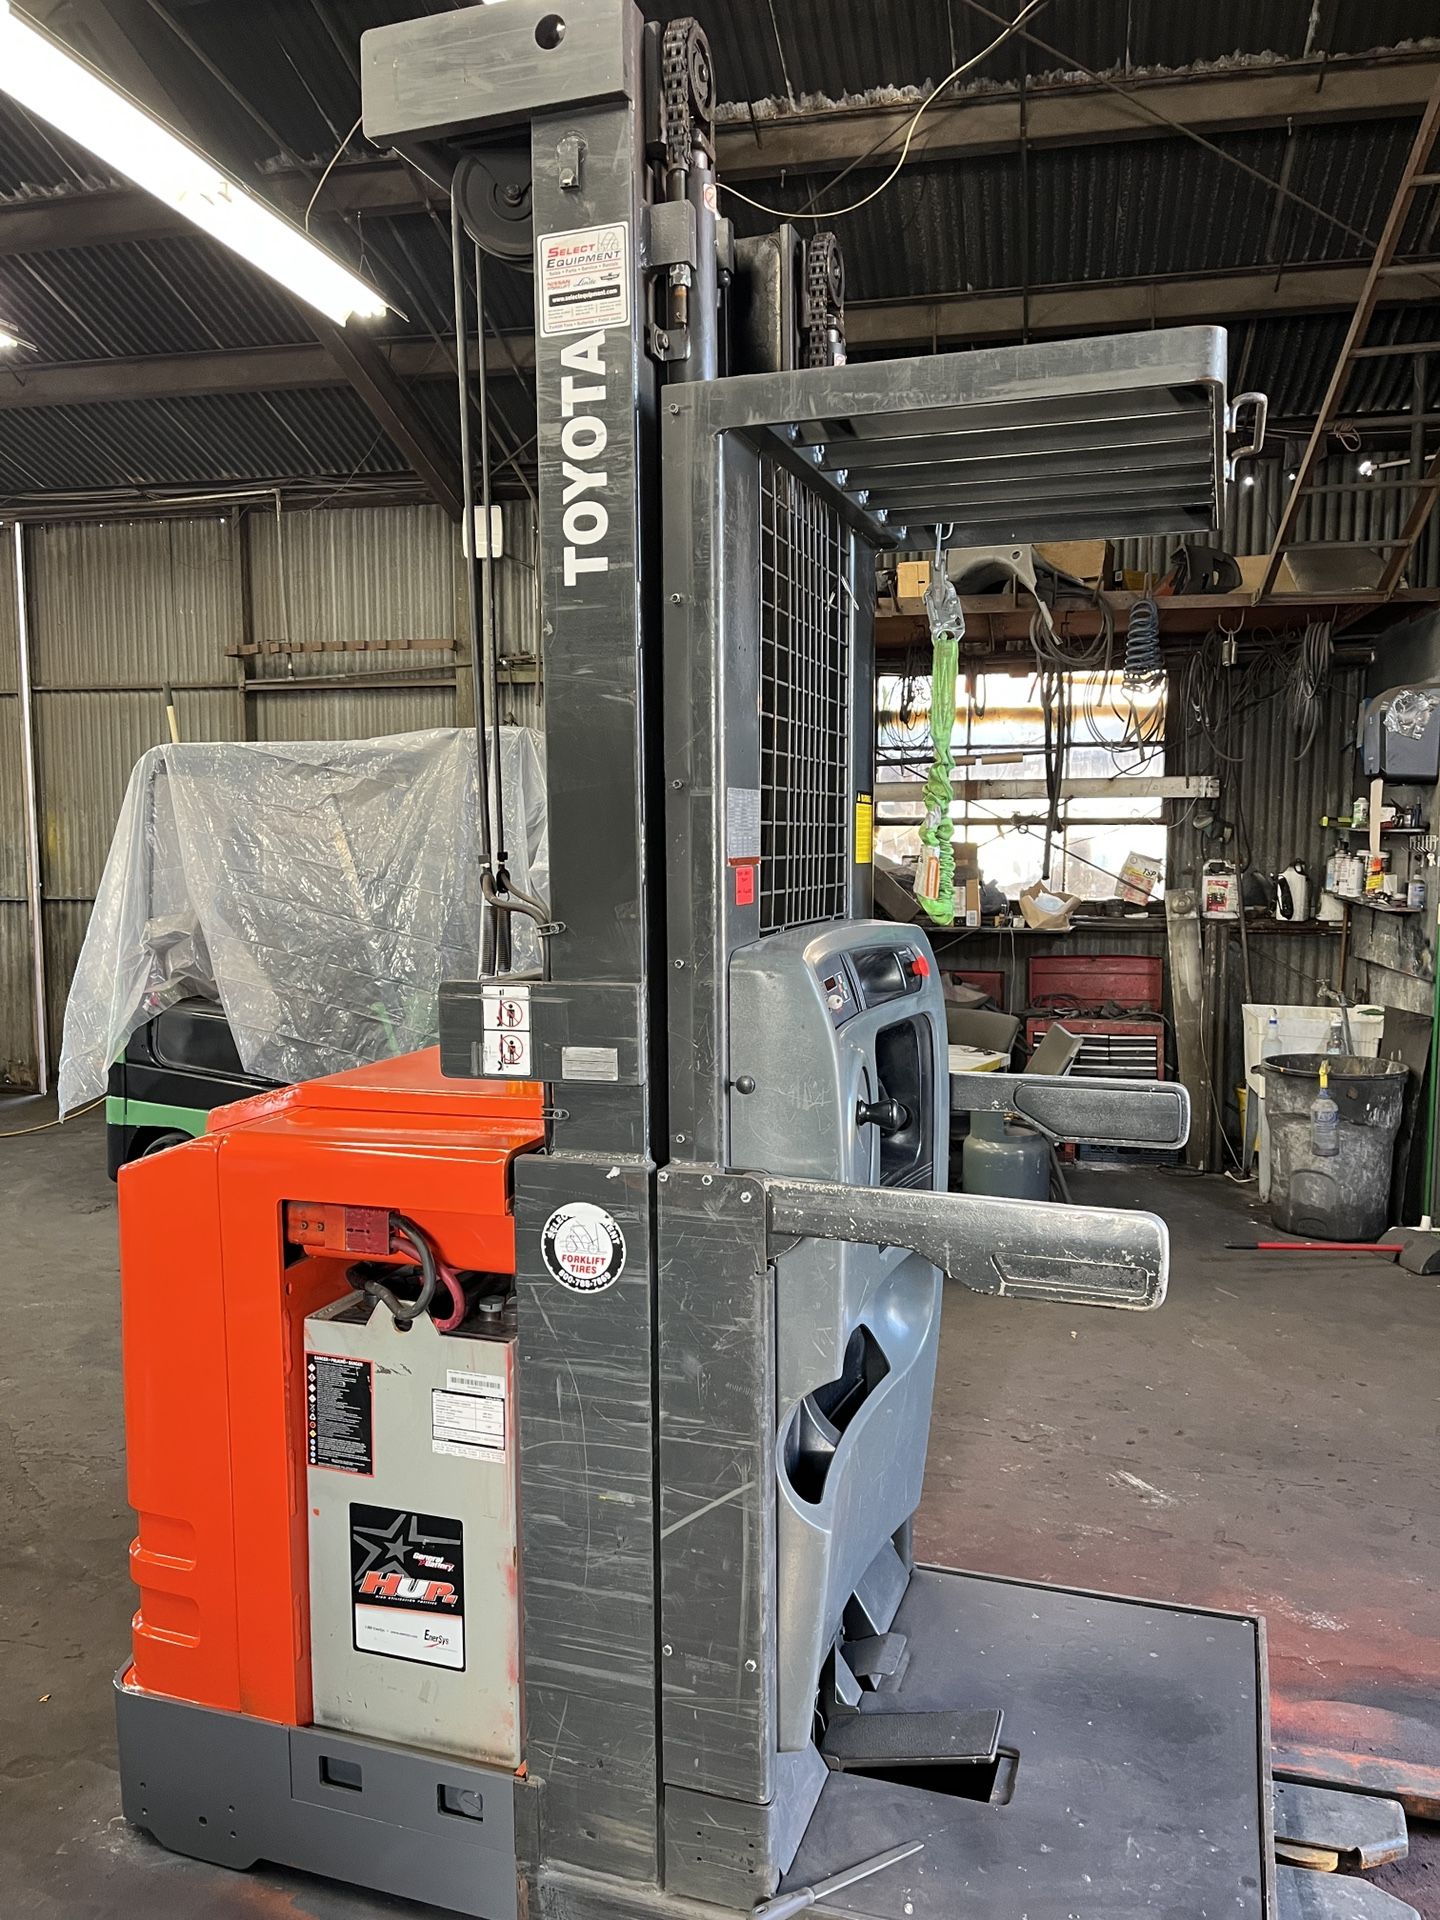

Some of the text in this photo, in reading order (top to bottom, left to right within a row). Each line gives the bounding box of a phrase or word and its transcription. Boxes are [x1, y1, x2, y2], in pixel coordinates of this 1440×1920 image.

[548, 244, 595, 258] SELECT
[547, 251, 620, 268] EQUIPMENT
[560, 329, 609, 586] TOYOTA
[562, 1254, 606, 1265] FORKLIFT
[570, 1264, 597, 1274] TIRES
[413, 1552, 444, 1563] General
[425, 1560, 455, 1572] Battery
[424, 1629, 449, 1645] EnerSys
